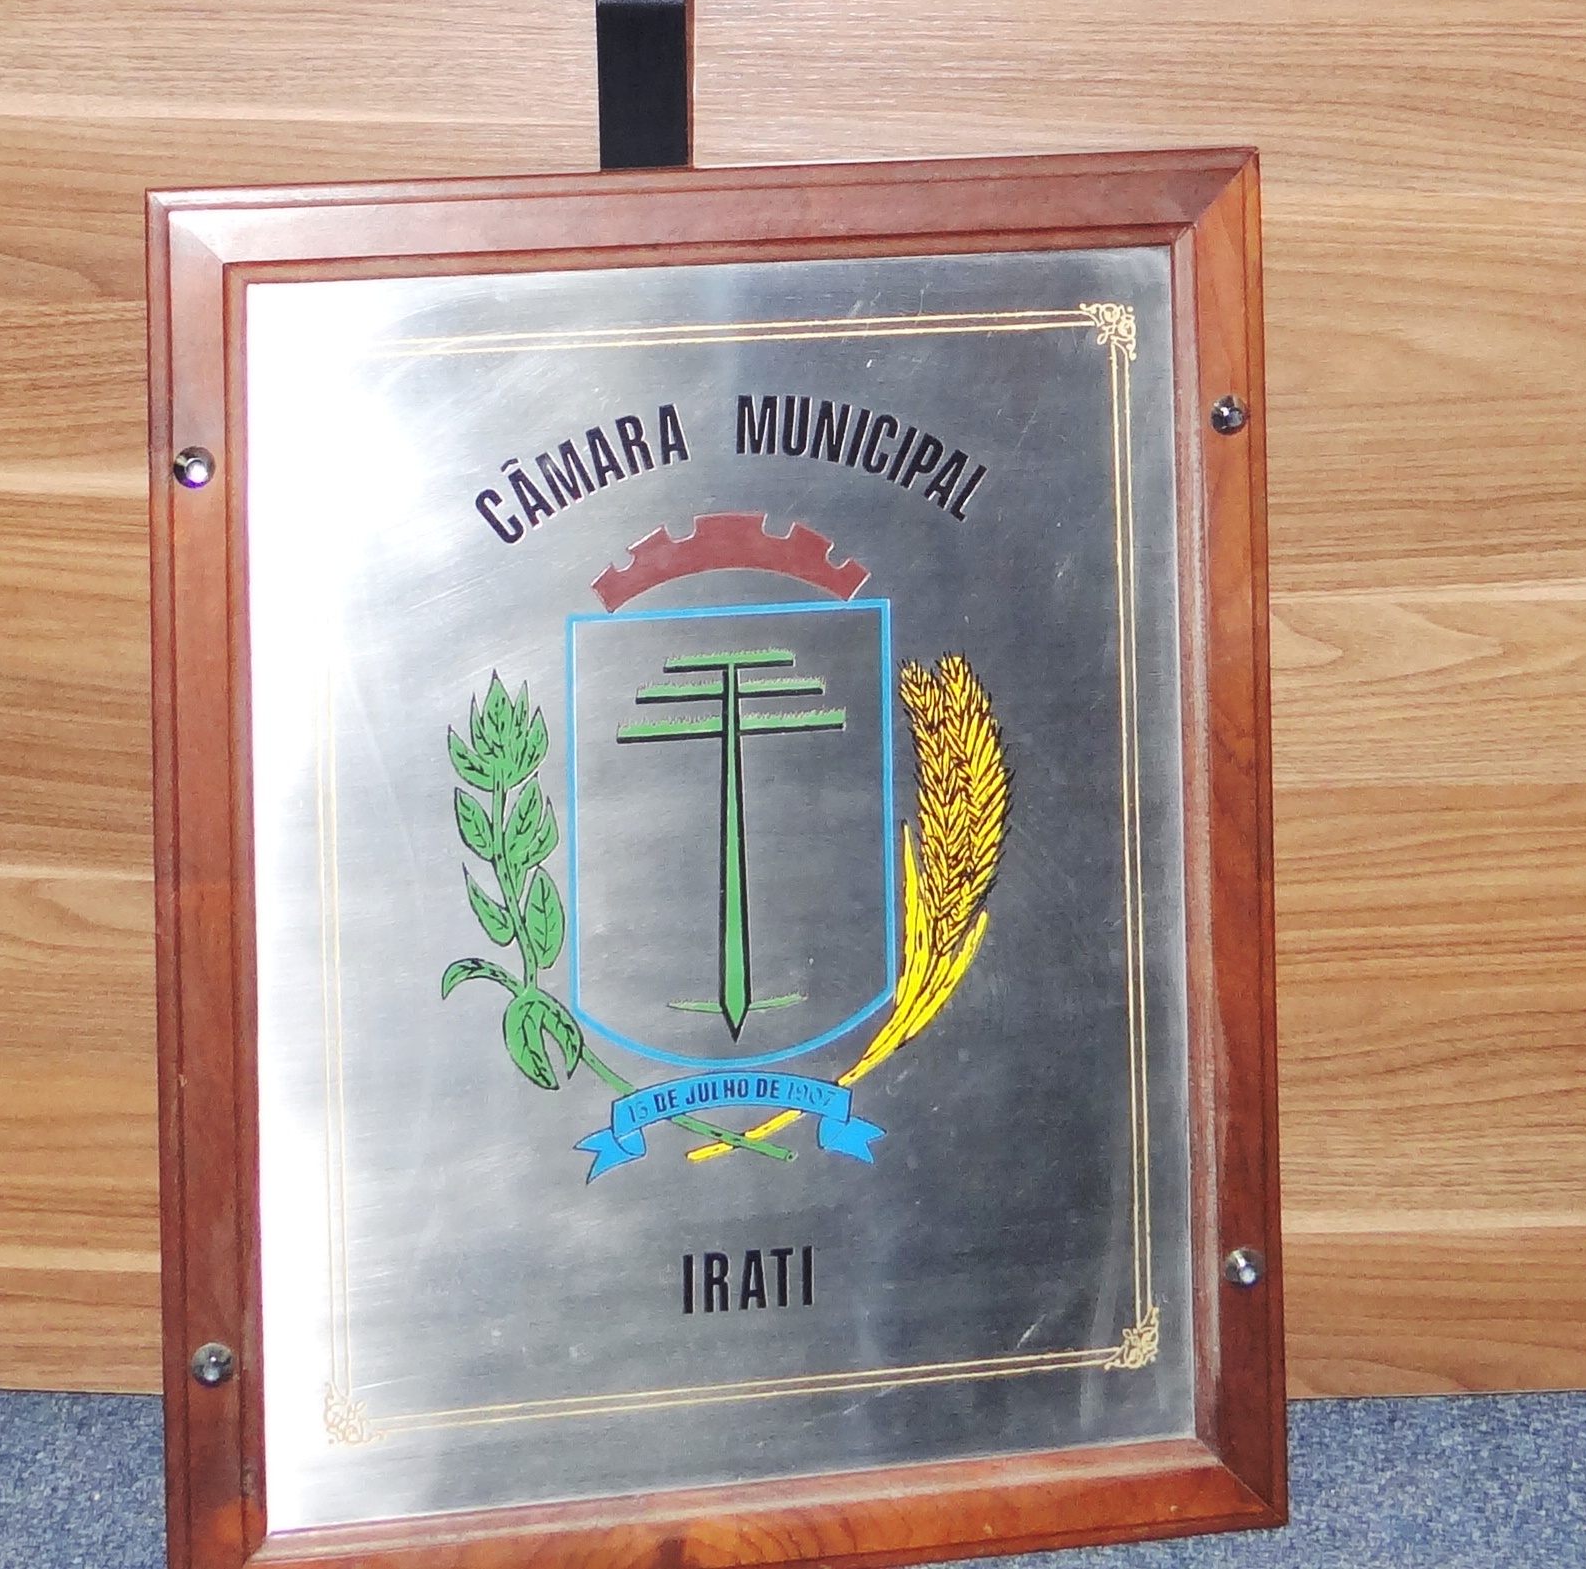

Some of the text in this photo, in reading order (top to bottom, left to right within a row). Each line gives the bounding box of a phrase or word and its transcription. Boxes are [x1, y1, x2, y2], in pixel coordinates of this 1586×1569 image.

[474, 394, 988, 545] CÂMARA MUNICIPAL
[653, 1089, 680, 1113] DE
[685, 1078, 749, 1106] JULHO
[756, 1078, 781, 1099] DE
[682, 1245, 813, 1314] IRATI
